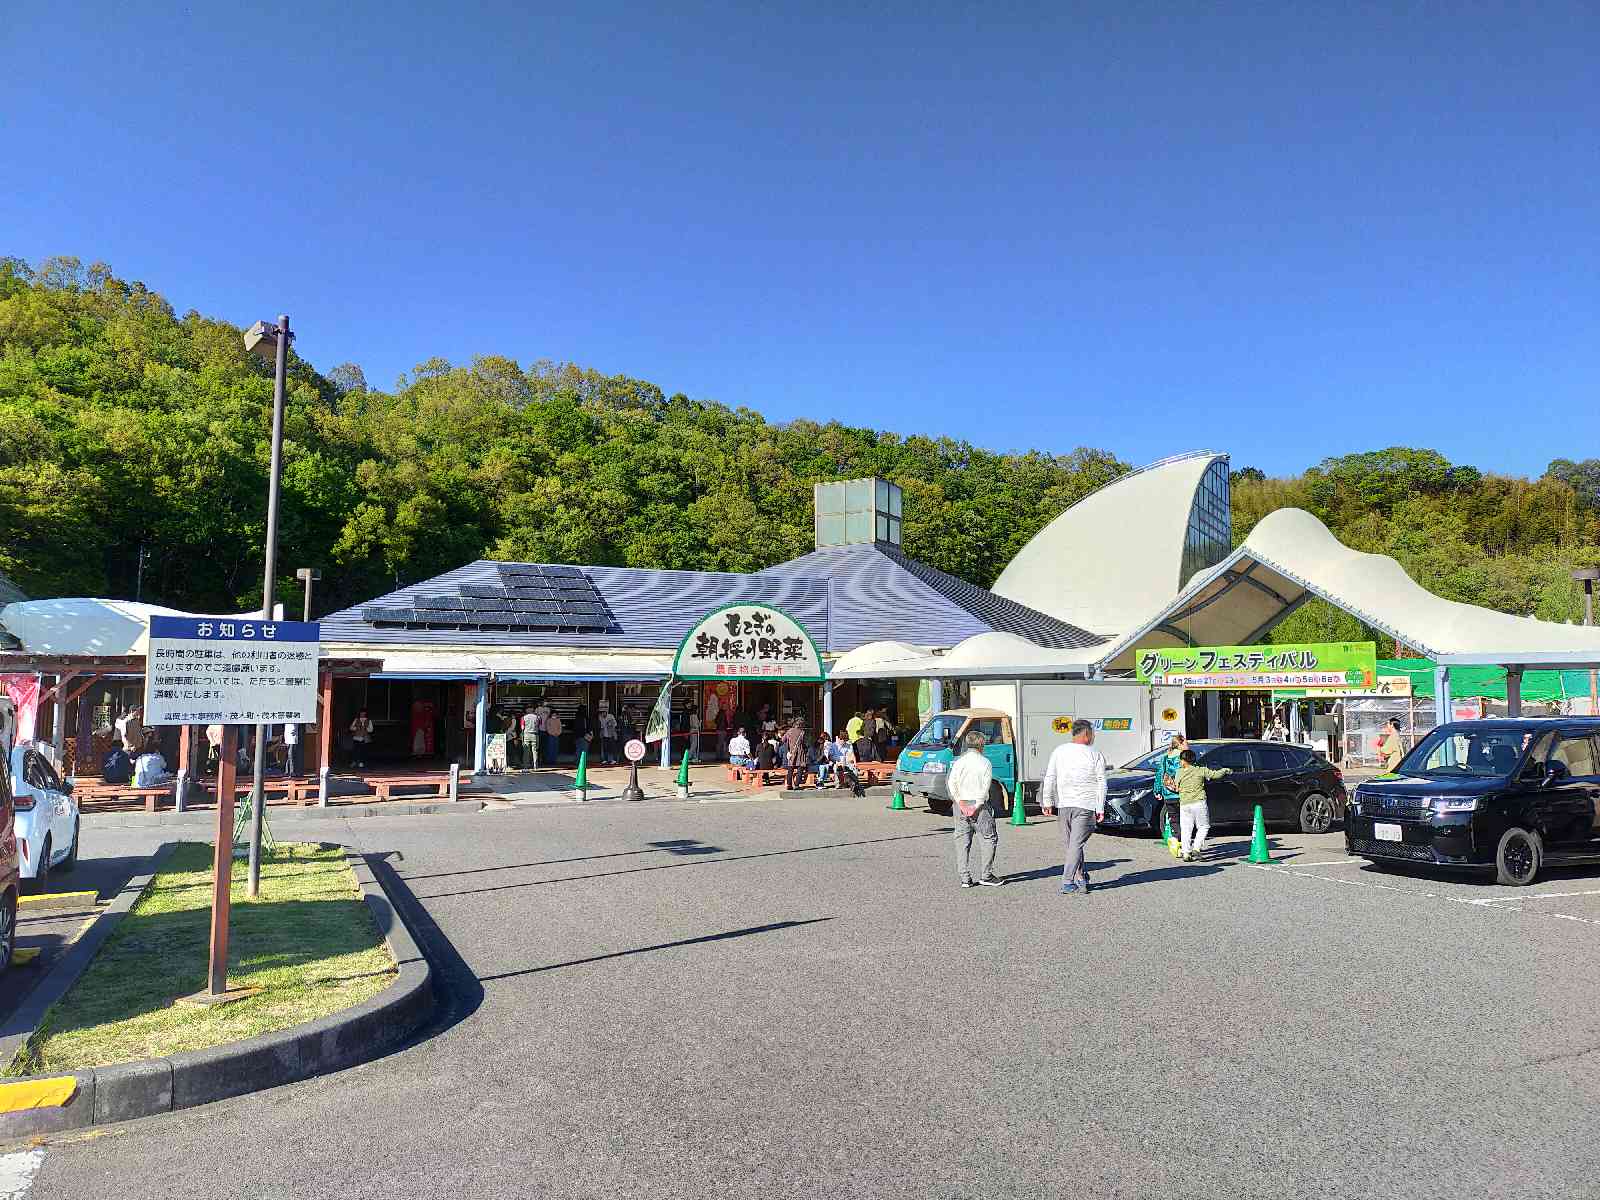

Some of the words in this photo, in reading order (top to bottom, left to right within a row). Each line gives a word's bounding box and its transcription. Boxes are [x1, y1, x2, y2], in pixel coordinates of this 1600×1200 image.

[197, 622, 277, 638] お知らせ
[691, 632, 807, 660] 朝採り野菜
[1140, 650, 1318, 677] グリーンフェスティバル
